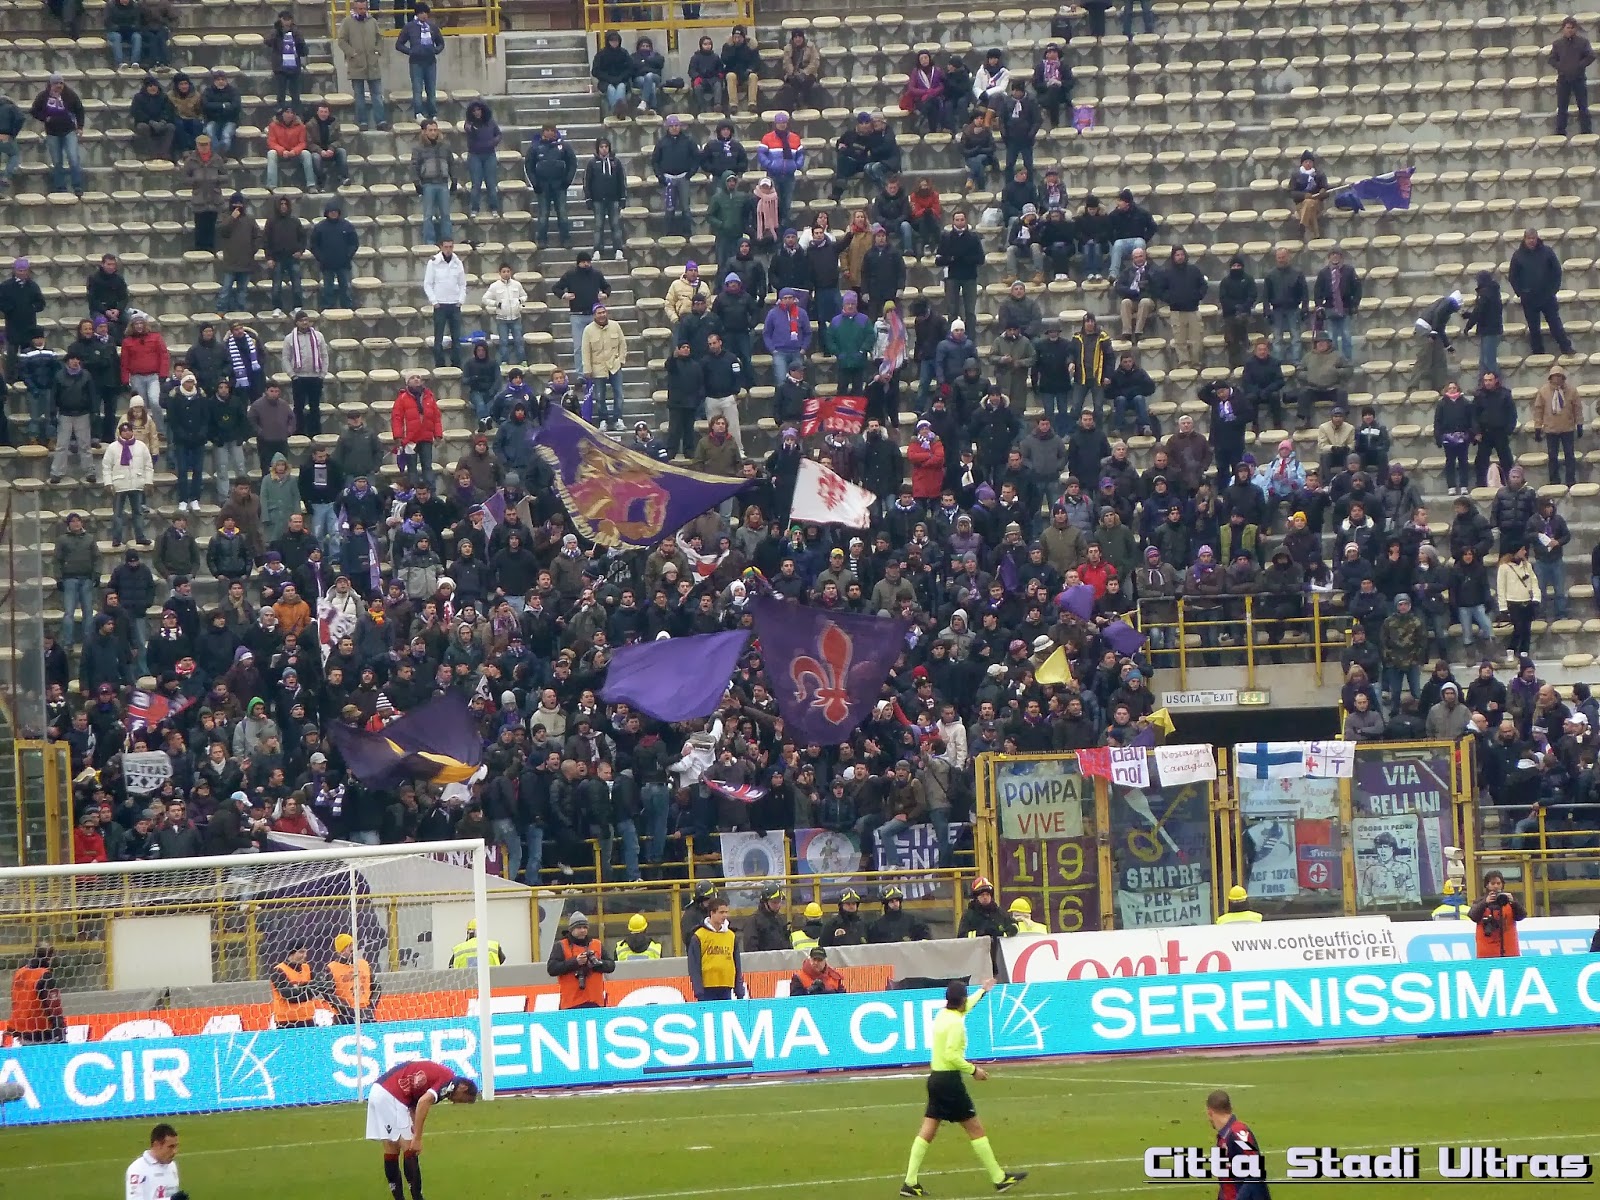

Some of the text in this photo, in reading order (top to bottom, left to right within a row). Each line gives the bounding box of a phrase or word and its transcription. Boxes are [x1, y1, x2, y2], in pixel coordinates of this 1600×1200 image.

[1166, 694, 1201, 704] USCITA
[1213, 692, 1234, 702] EXIT
[1115, 764, 1142, 784] noi
[1331, 760, 1345, 774] T
[1382, 764, 1421, 786] VIA
[1004, 778, 1078, 808] POMPA
[1370, 791, 1441, 815] BELLINI
[1017, 811, 1066, 835] VIVE
[1013, 842, 1084, 882] 1 9
[1126, 862, 1203, 890] SEMPRE
[1180, 886, 1199, 903] LEI
[1261, 883, 1286, 894] Fans
[1058, 895, 1084, 932] 6
[1135, 903, 1201, 926] FACCIAM
[1232, 929, 1394, 952] www.conteufficio.it
[1303, 945, 1397, 961] CENTO (FE)
[1091, 967, 1558, 1039] SERENISSIMA
[331, 1007, 831, 1088] SERENISSIMA
[63, 1048, 192, 1107] CIR
